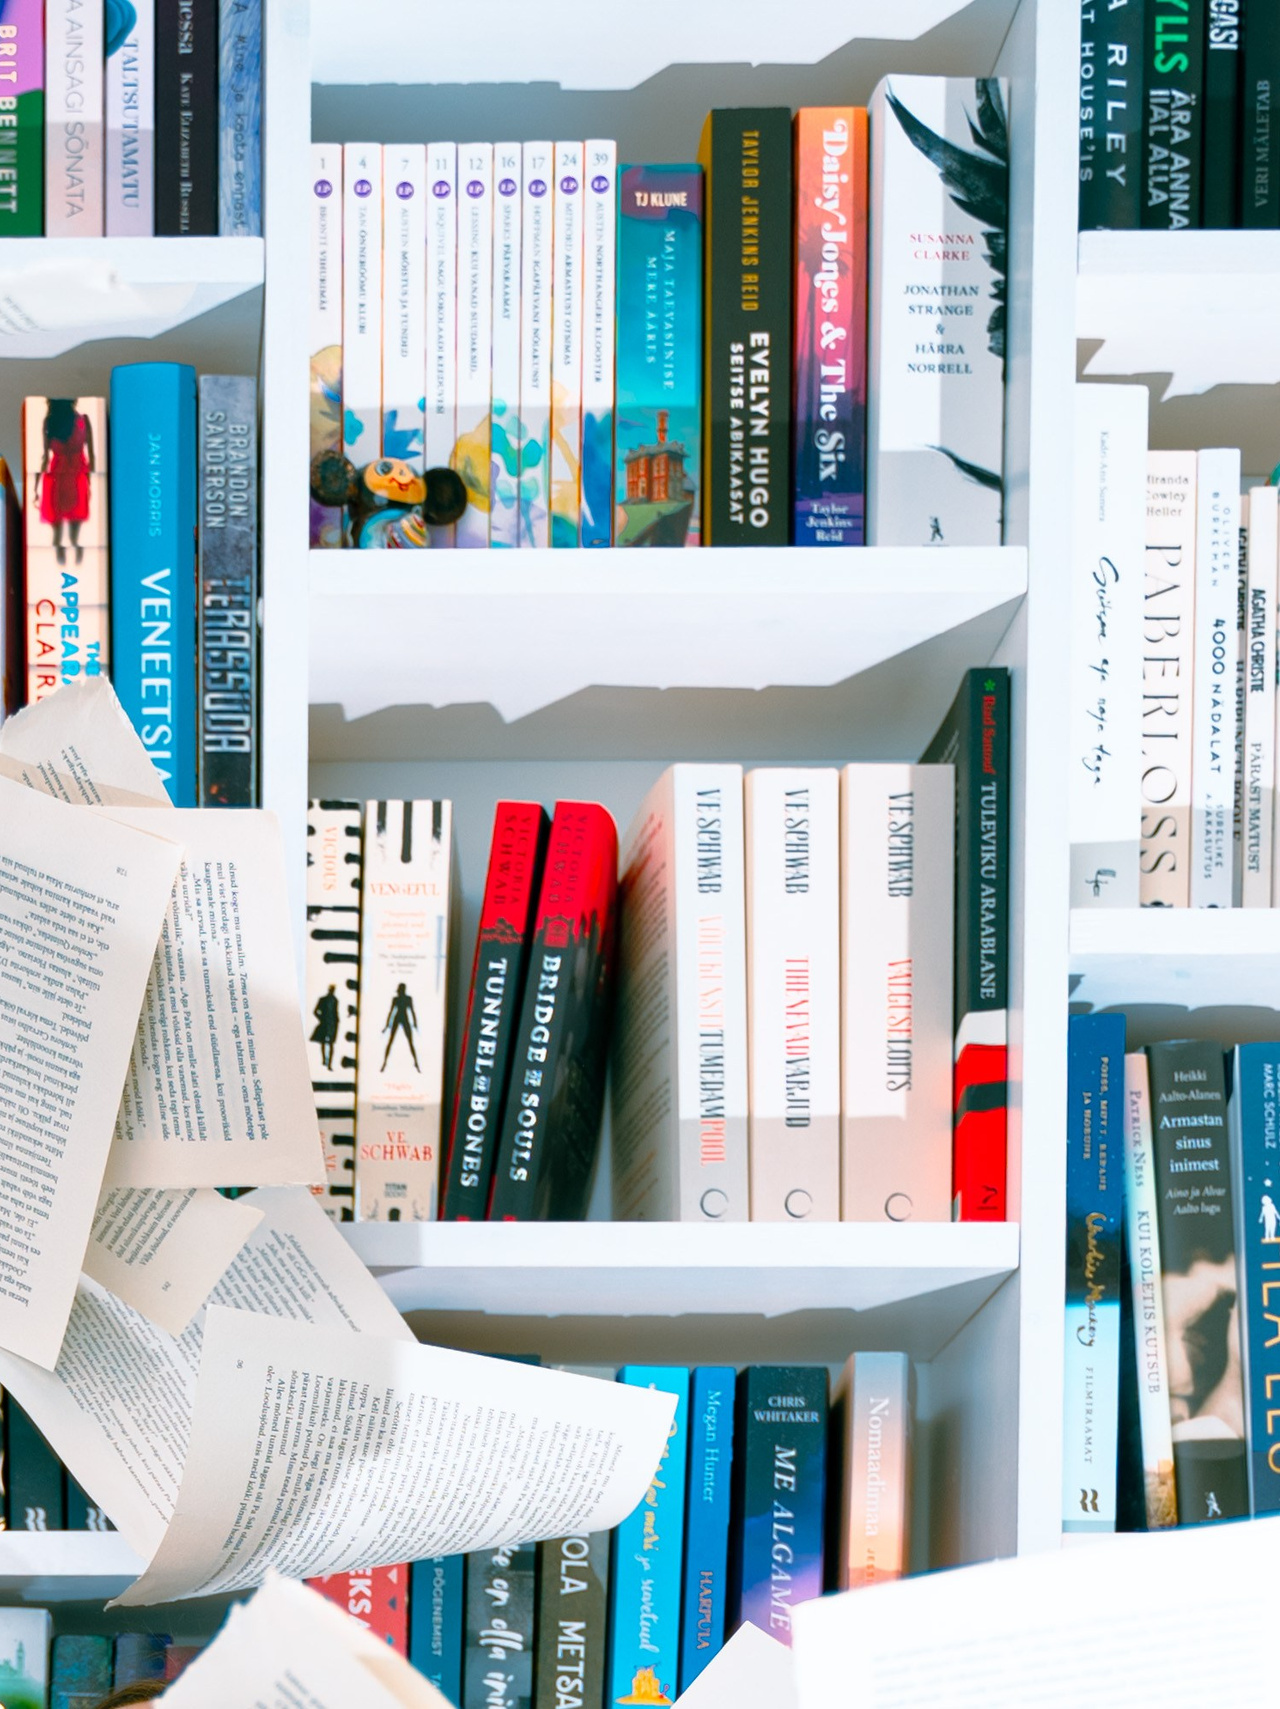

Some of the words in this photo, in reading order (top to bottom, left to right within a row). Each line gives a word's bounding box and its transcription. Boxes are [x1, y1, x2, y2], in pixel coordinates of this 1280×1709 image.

[66, 18, 85, 113] AINSAGI
[121, 38, 140, 209] TALTSUTAMATU
[1106, 43, 1128, 187] RILEY
[1170, 89, 1197, 144] ÄRA
[66, 122, 89, 219] SÕNATA
[742, 130, 760, 188] TAYLOR
[814, 118, 850, 225] Daisy
[1168, 151, 1192, 230] ANNA
[634, 191, 649, 206] TJ
[650, 191, 688, 206] KLUNE
[663, 230, 677, 273] MAJA
[741, 195, 760, 267] JENKINS
[910, 233, 975, 246] SUSANNA
[914, 250, 972, 261] CLARKE
[399, 250, 411, 296] MÕISTUS
[502, 243, 514, 320] PÄEVARAAMAT
[562, 254, 574, 317] ARMASTUST
[742, 273, 760, 312] REID
[814, 223, 849, 313] Jones
[903, 285, 979, 297] JONATHAN
[400, 313, 410, 358] TUNDED
[562, 318, 573, 366] OTSIMAS
[663, 279, 677, 391] TAEVASINISE
[820, 321, 846, 350] &
[908, 306, 974, 317] STRANGE
[729, 342, 745, 410] SEITSE
[749, 331, 770, 438] EVELYN
[819, 359, 847, 422] The
[908, 365, 973, 376] NORRELL
[148, 432, 162, 468] JAN
[204, 410, 227, 530] SANDERSON
[229, 423, 251, 518] BRANDON
[729, 415, 745, 524] ABIKAASAT
[814, 429, 846, 483] Six
[148, 471, 162, 538] MORRIS
[749, 447, 770, 529] HUGO
[1250, 588, 1267, 639] AGATHA
[85, 641, 102, 677] THE
[202, 574, 252, 755] TERASSÜDA
[1211, 617, 1227, 675] 4000
[1250, 640, 1267, 693] CHRISTIE
[1140, 543, 1184, 876] PABERLOSS
[1209, 683, 1228, 775] NÄDALAT
[1248, 742, 1266, 804] PÄRAST
[323, 825, 339, 893] VICIOUS
[979, 782, 1000, 879] TULEVIKU
[1248, 806, 1265, 873] MATUST
[978, 884, 999, 999] ARAABLANE
[239, 971, 249, 996] Tema
[525, 953, 563, 1064] BRIDGE
[473, 957, 510, 1075] TUNNEL
[1174, 1069, 1207, 1083] Heikki
[1261, 1063, 1274, 1099] MARC
[458, 1092, 488, 1188] BONES
[507, 1091, 540, 1183] SOULS
[1159, 1114, 1223, 1130] Armastan
[1175, 1135, 1212, 1150] sinus
[1262, 1100, 1277, 1149] SCHULZ
[1169, 1158, 1221, 1174] inimest
[1137, 1209, 1154, 1243] KUI
[1138, 1245, 1159, 1322] KOLETIS
[1142, 1325, 1161, 1395] KUTSUB
[309, 1374, 324, 1428] Loomulikult
[702, 1389, 723, 1443] Megan
[1083, 1366, 1096, 1466] FILMIRAAMAT
[703, 1447, 720, 1504] Hunter
[773, 1445, 798, 1491] ME
[862, 1396, 891, 1538] Nomaadimaa
[486, 1578, 510, 1608] on
[769, 1499, 797, 1632] ALGAME
[479, 1617, 525, 1660] olla
[696, 1570, 715, 1650] HARPUIA
